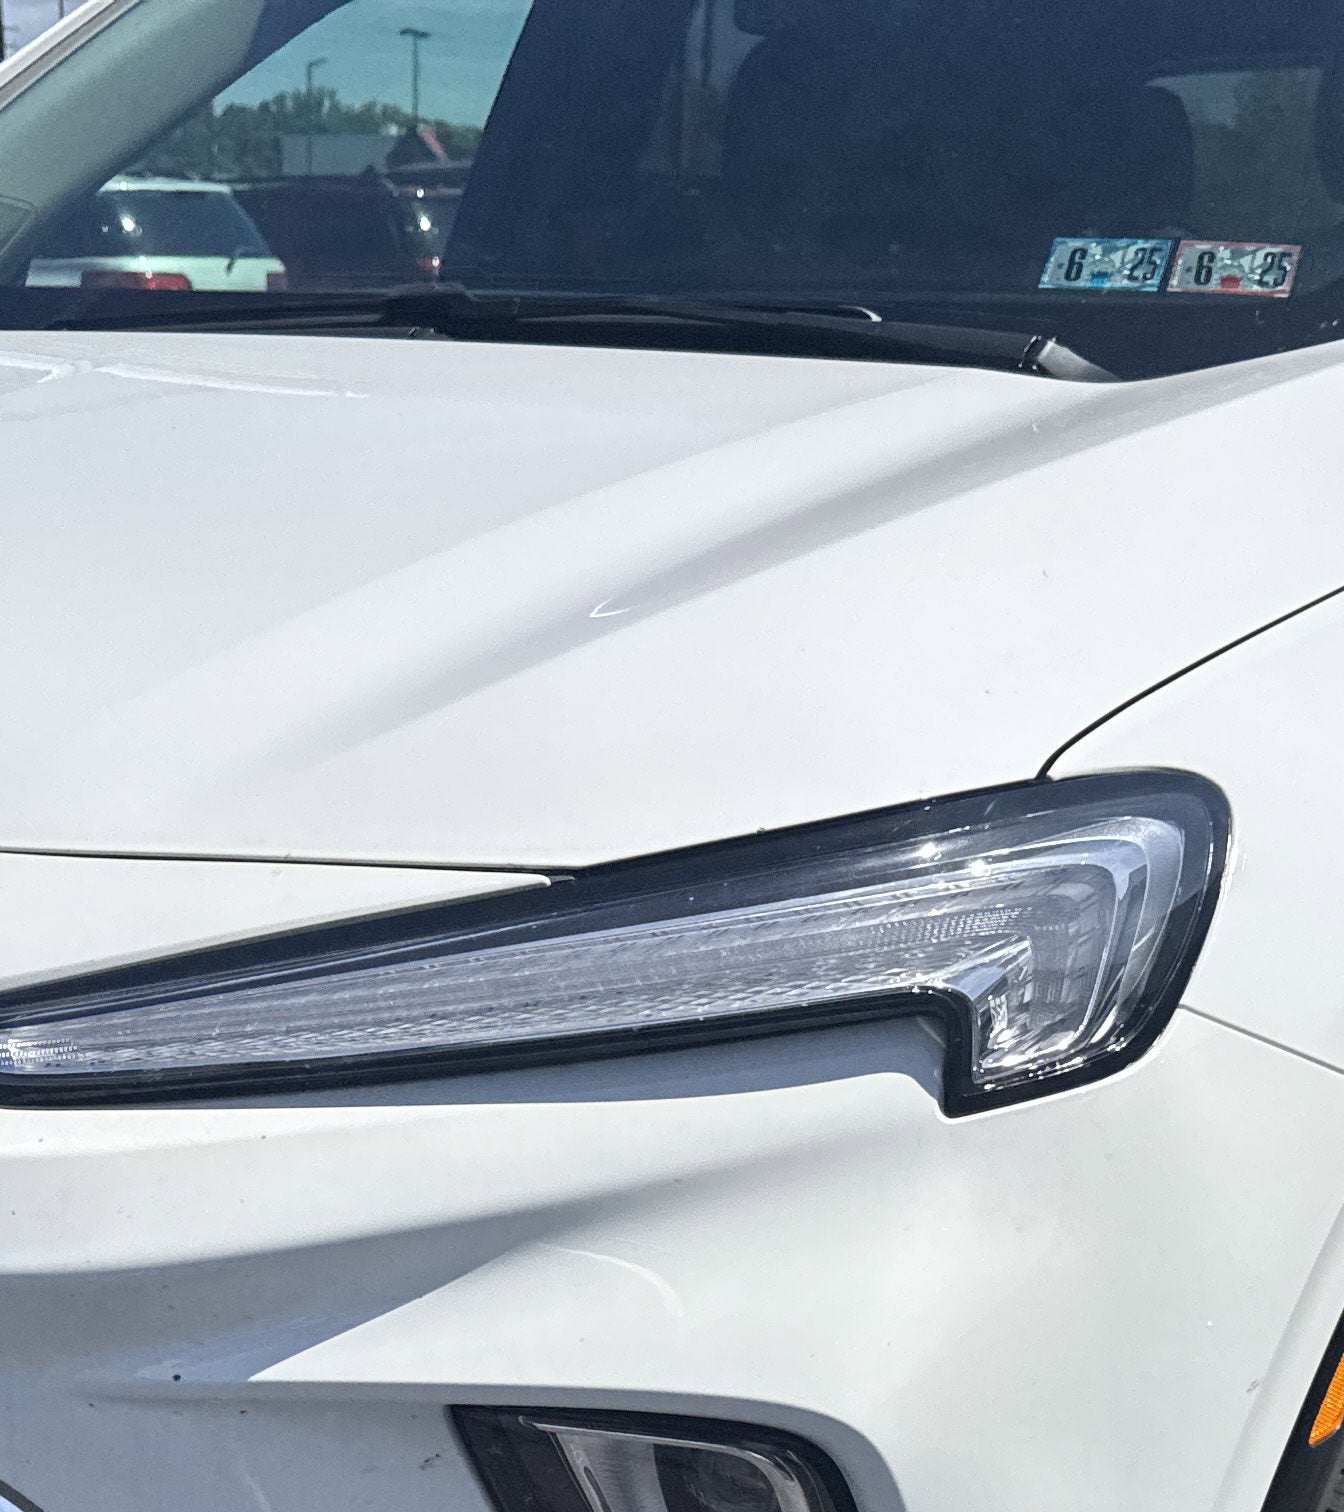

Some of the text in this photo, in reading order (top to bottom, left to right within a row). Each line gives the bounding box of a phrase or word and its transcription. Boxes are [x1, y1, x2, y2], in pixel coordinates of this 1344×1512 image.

[1064, 247, 1163, 281] 6 25
[1194, 250, 1293, 288] 6 25
